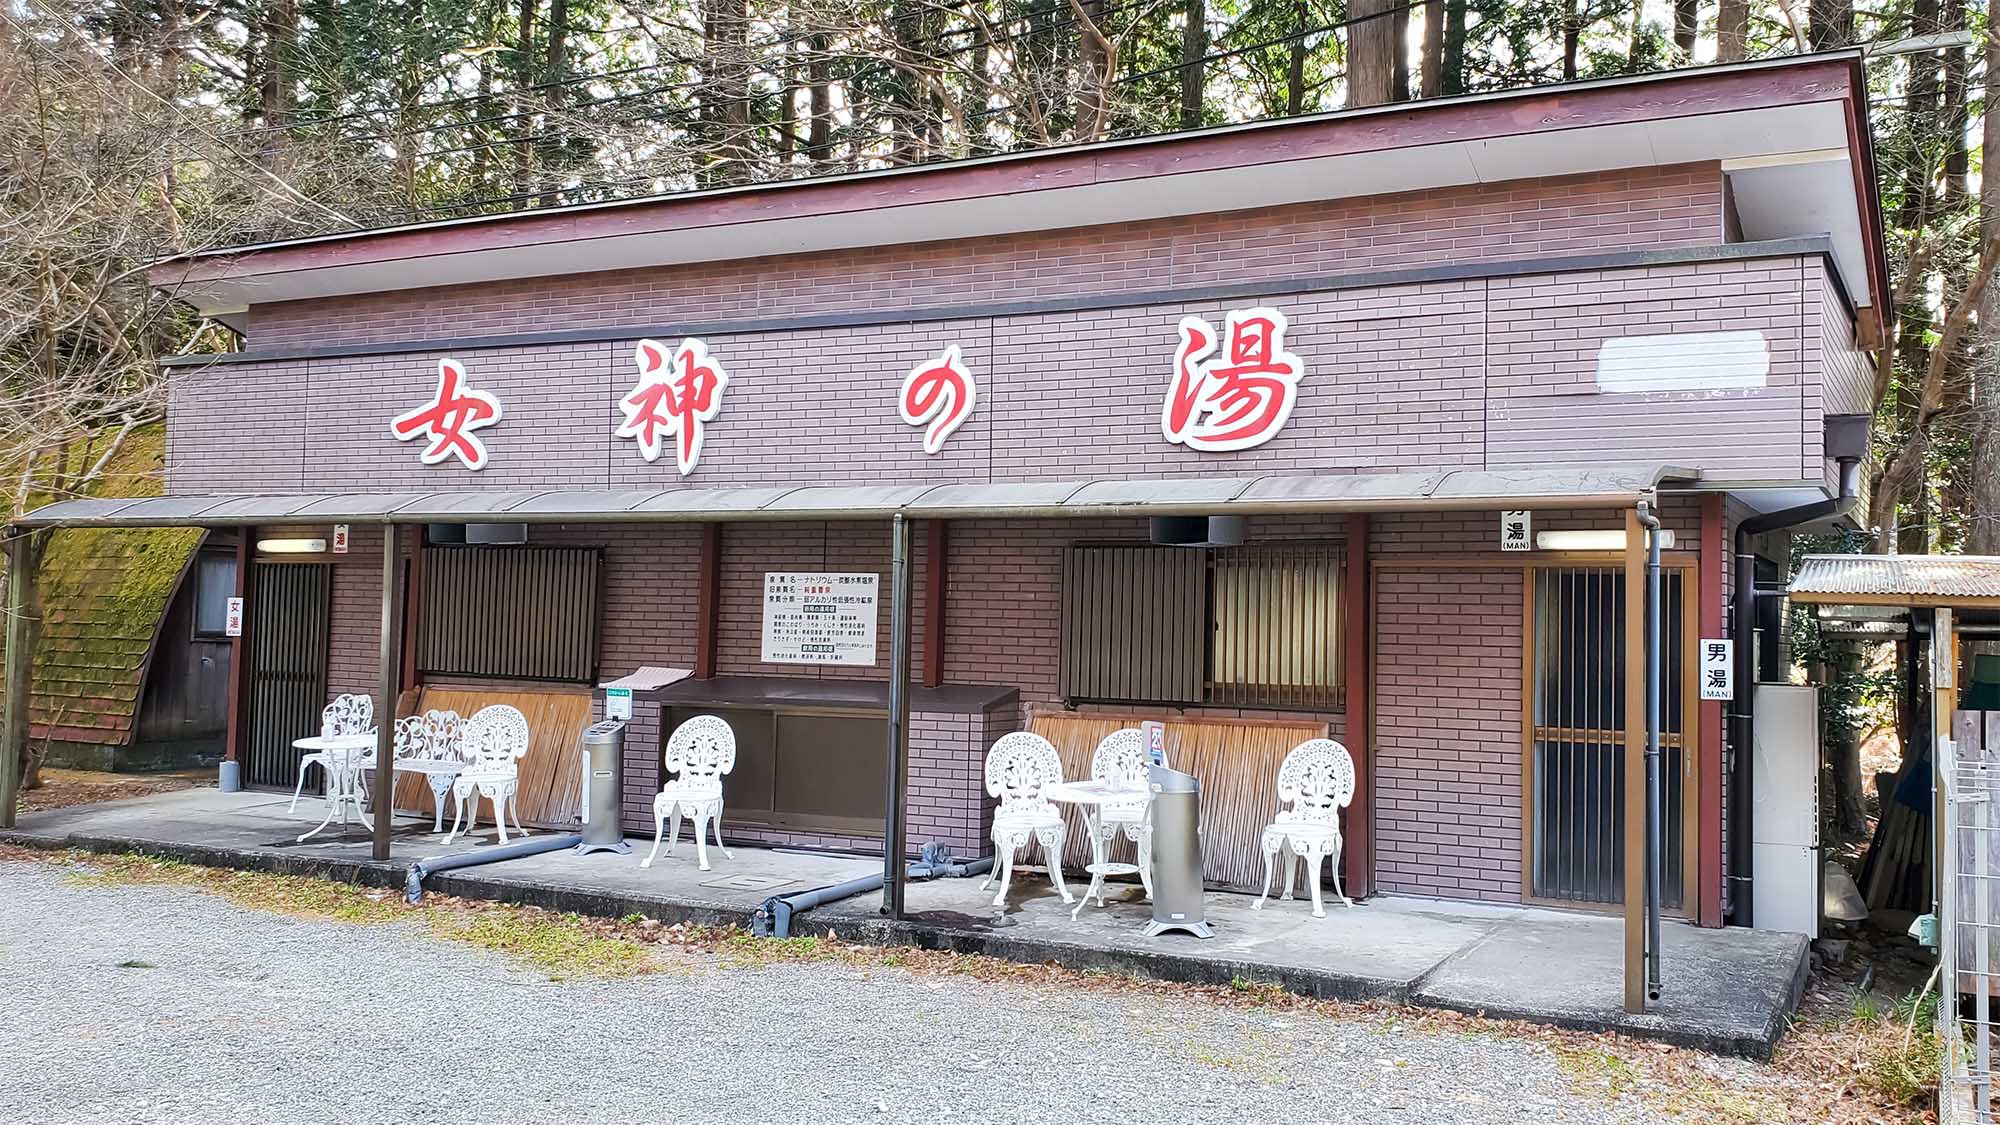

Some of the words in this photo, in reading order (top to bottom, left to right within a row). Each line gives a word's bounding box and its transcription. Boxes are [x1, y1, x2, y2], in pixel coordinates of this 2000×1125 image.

[392, 310, 1300, 470] 女神の湯
[1502, 541, 1530, 551] (MAN)
[229, 600, 240, 629] 女湯
[1708, 643, 1727, 688] 男湯
[1702, 690, 1732, 699] (MAN)
